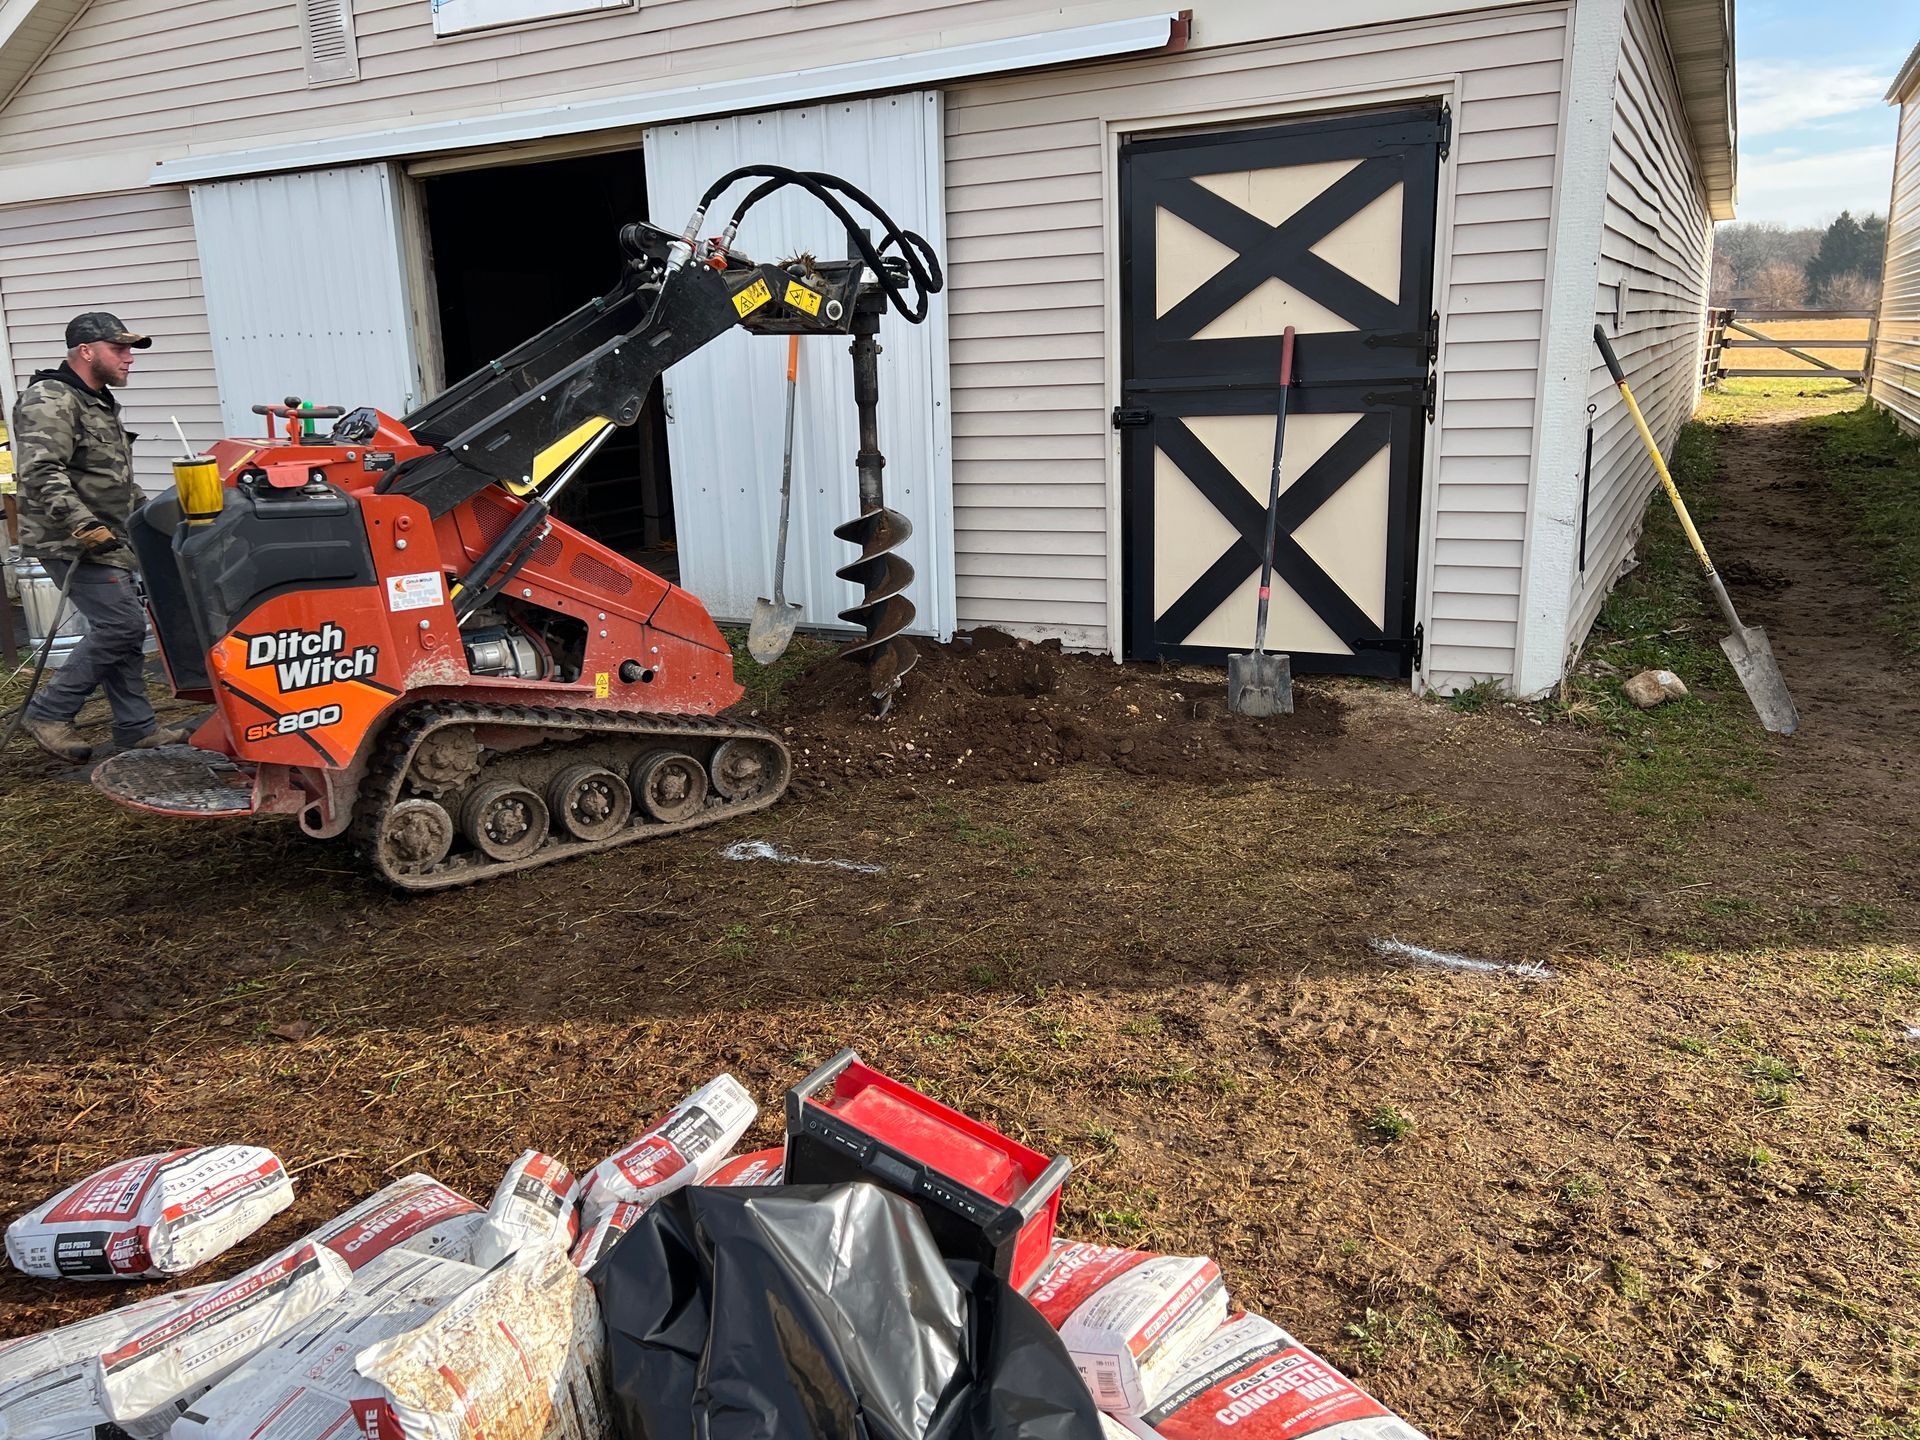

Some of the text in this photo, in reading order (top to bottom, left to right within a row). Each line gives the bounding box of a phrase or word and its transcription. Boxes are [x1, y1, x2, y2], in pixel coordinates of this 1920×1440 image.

[250, 624, 343, 666] Ditch
[278, 648, 376, 690] Witch
[247, 705, 341, 741] SK800
[119, 1181, 140, 1210] SET
[344, 1192, 450, 1252] CONCRETE
[194, 1275, 259, 1320] CONCRETE
[259, 1264, 287, 1285] MIX
[186, 1326, 260, 1369] MASTERCRAFT
[1215, 1362, 1331, 1427] CONCRETE
[1230, 1356, 1304, 1396] FAST SET
[1300, 1377, 1350, 1402] MIX
